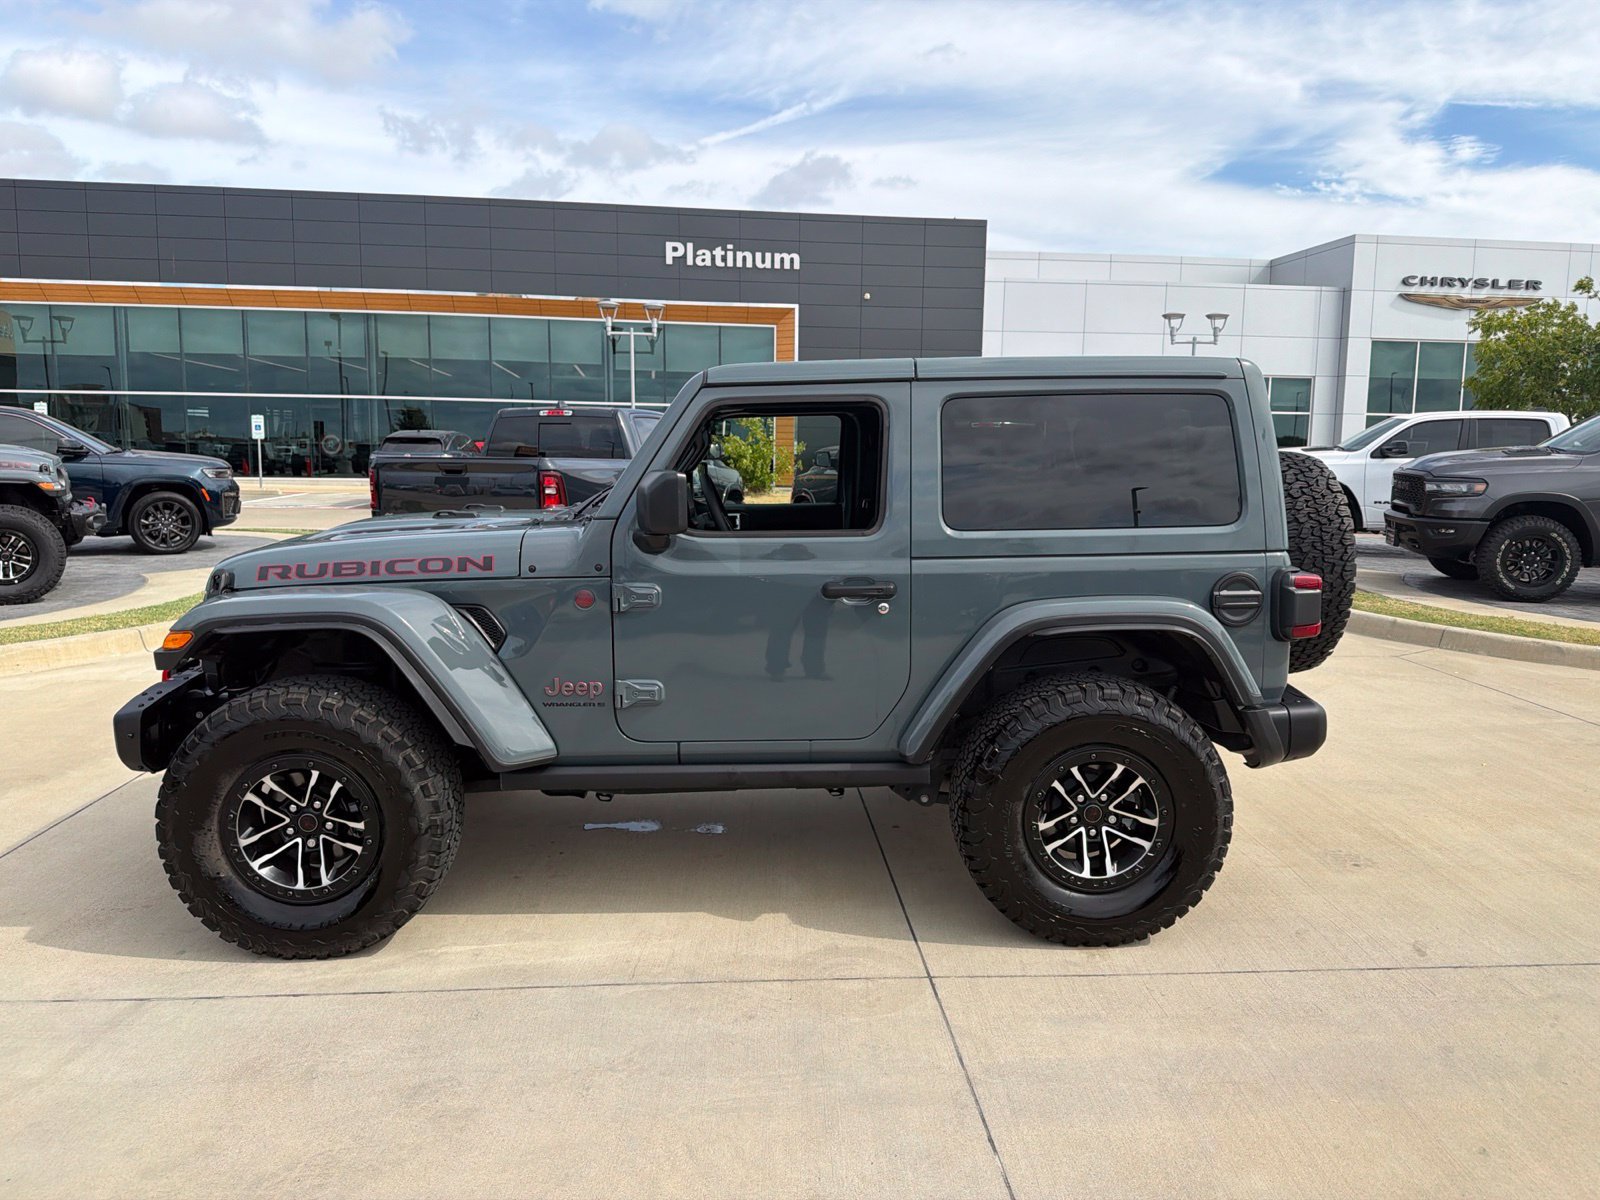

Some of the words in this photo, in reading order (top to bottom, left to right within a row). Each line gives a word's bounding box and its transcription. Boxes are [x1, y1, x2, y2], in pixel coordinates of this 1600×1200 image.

[665, 241, 800, 270] Platinum
[1401, 275, 1542, 290] CHRYSLER
[257, 555, 494, 582] RUBICON
[544, 677, 604, 700] Jeep
